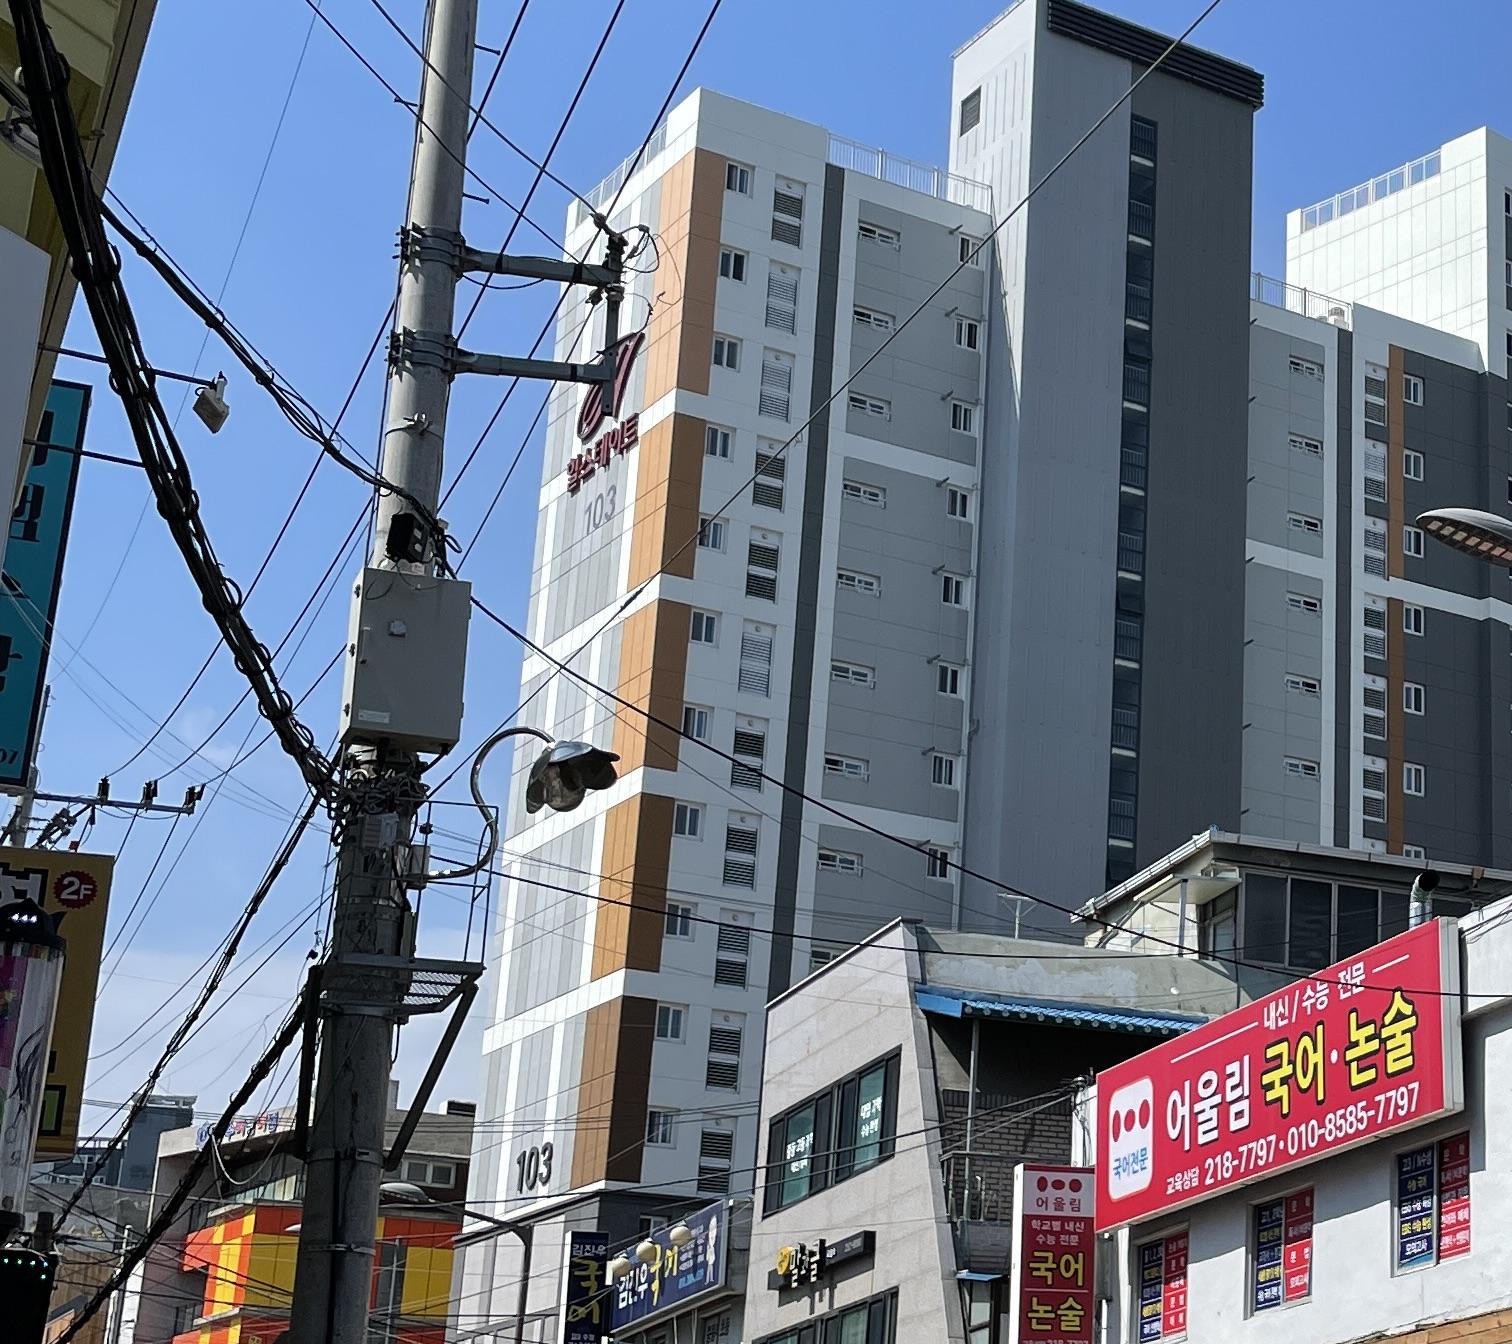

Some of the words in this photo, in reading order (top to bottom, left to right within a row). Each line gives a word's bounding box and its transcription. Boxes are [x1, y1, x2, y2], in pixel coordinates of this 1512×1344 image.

[585, 484, 617, 535] 103
[60, 877, 94, 900] 2F
[1337, 961, 1366, 1000] 전문
[1166, 1055, 1251, 1150] 어울림
[516, 1141, 553, 1194] 103
[1112, 1147, 1149, 1181] 국어전문
[1165, 1166, 1200, 1195] 교육상담
[1036, 1234, 1056, 1244] 수능
[1059, 1235, 1080, 1246] 전문
[1065, 1221, 1085, 1233] 내신
[1029, 1251, 1084, 1287] 국어
[1027, 1296, 1085, 1333] 논술
